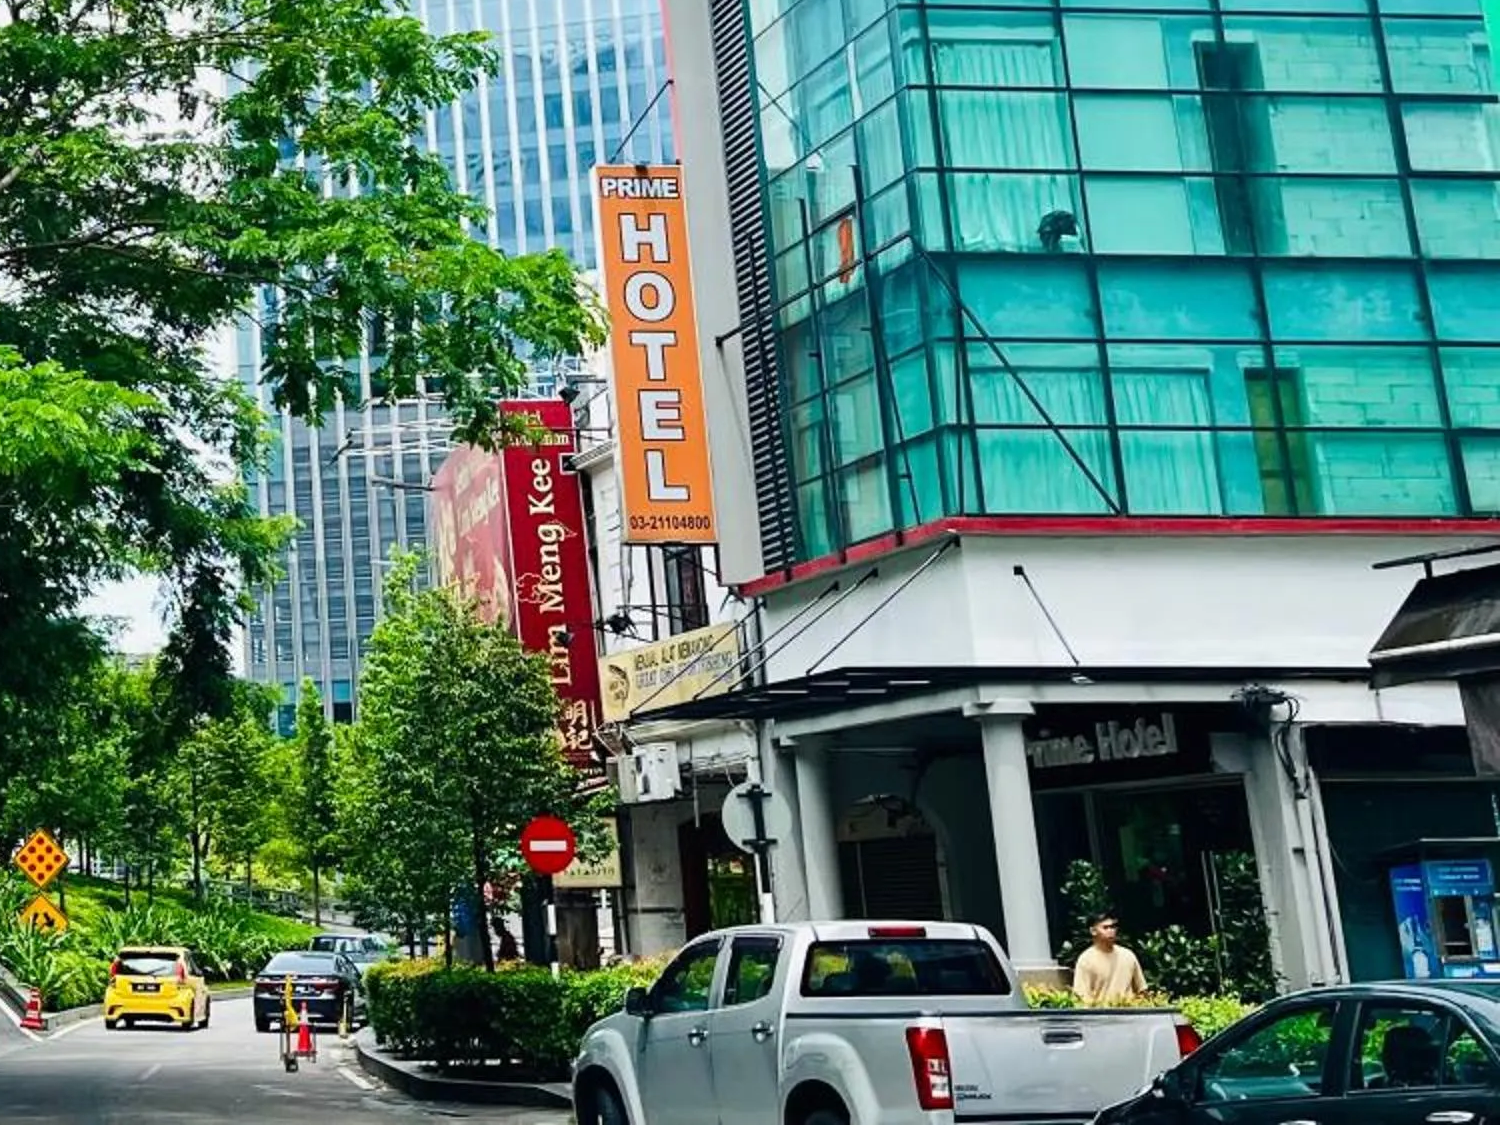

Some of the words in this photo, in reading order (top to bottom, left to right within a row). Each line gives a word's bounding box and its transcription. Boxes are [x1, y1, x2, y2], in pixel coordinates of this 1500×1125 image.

[600, 177, 679, 198] PRIME
[618, 212, 691, 502] HOTEL
[527, 458, 555, 516] Kee
[629, 515, 712, 530] 03-21104800
[537, 523, 567, 614] Meng
[547, 624, 572, 687] Lim
[1095, 712, 1179, 761] Hotel
